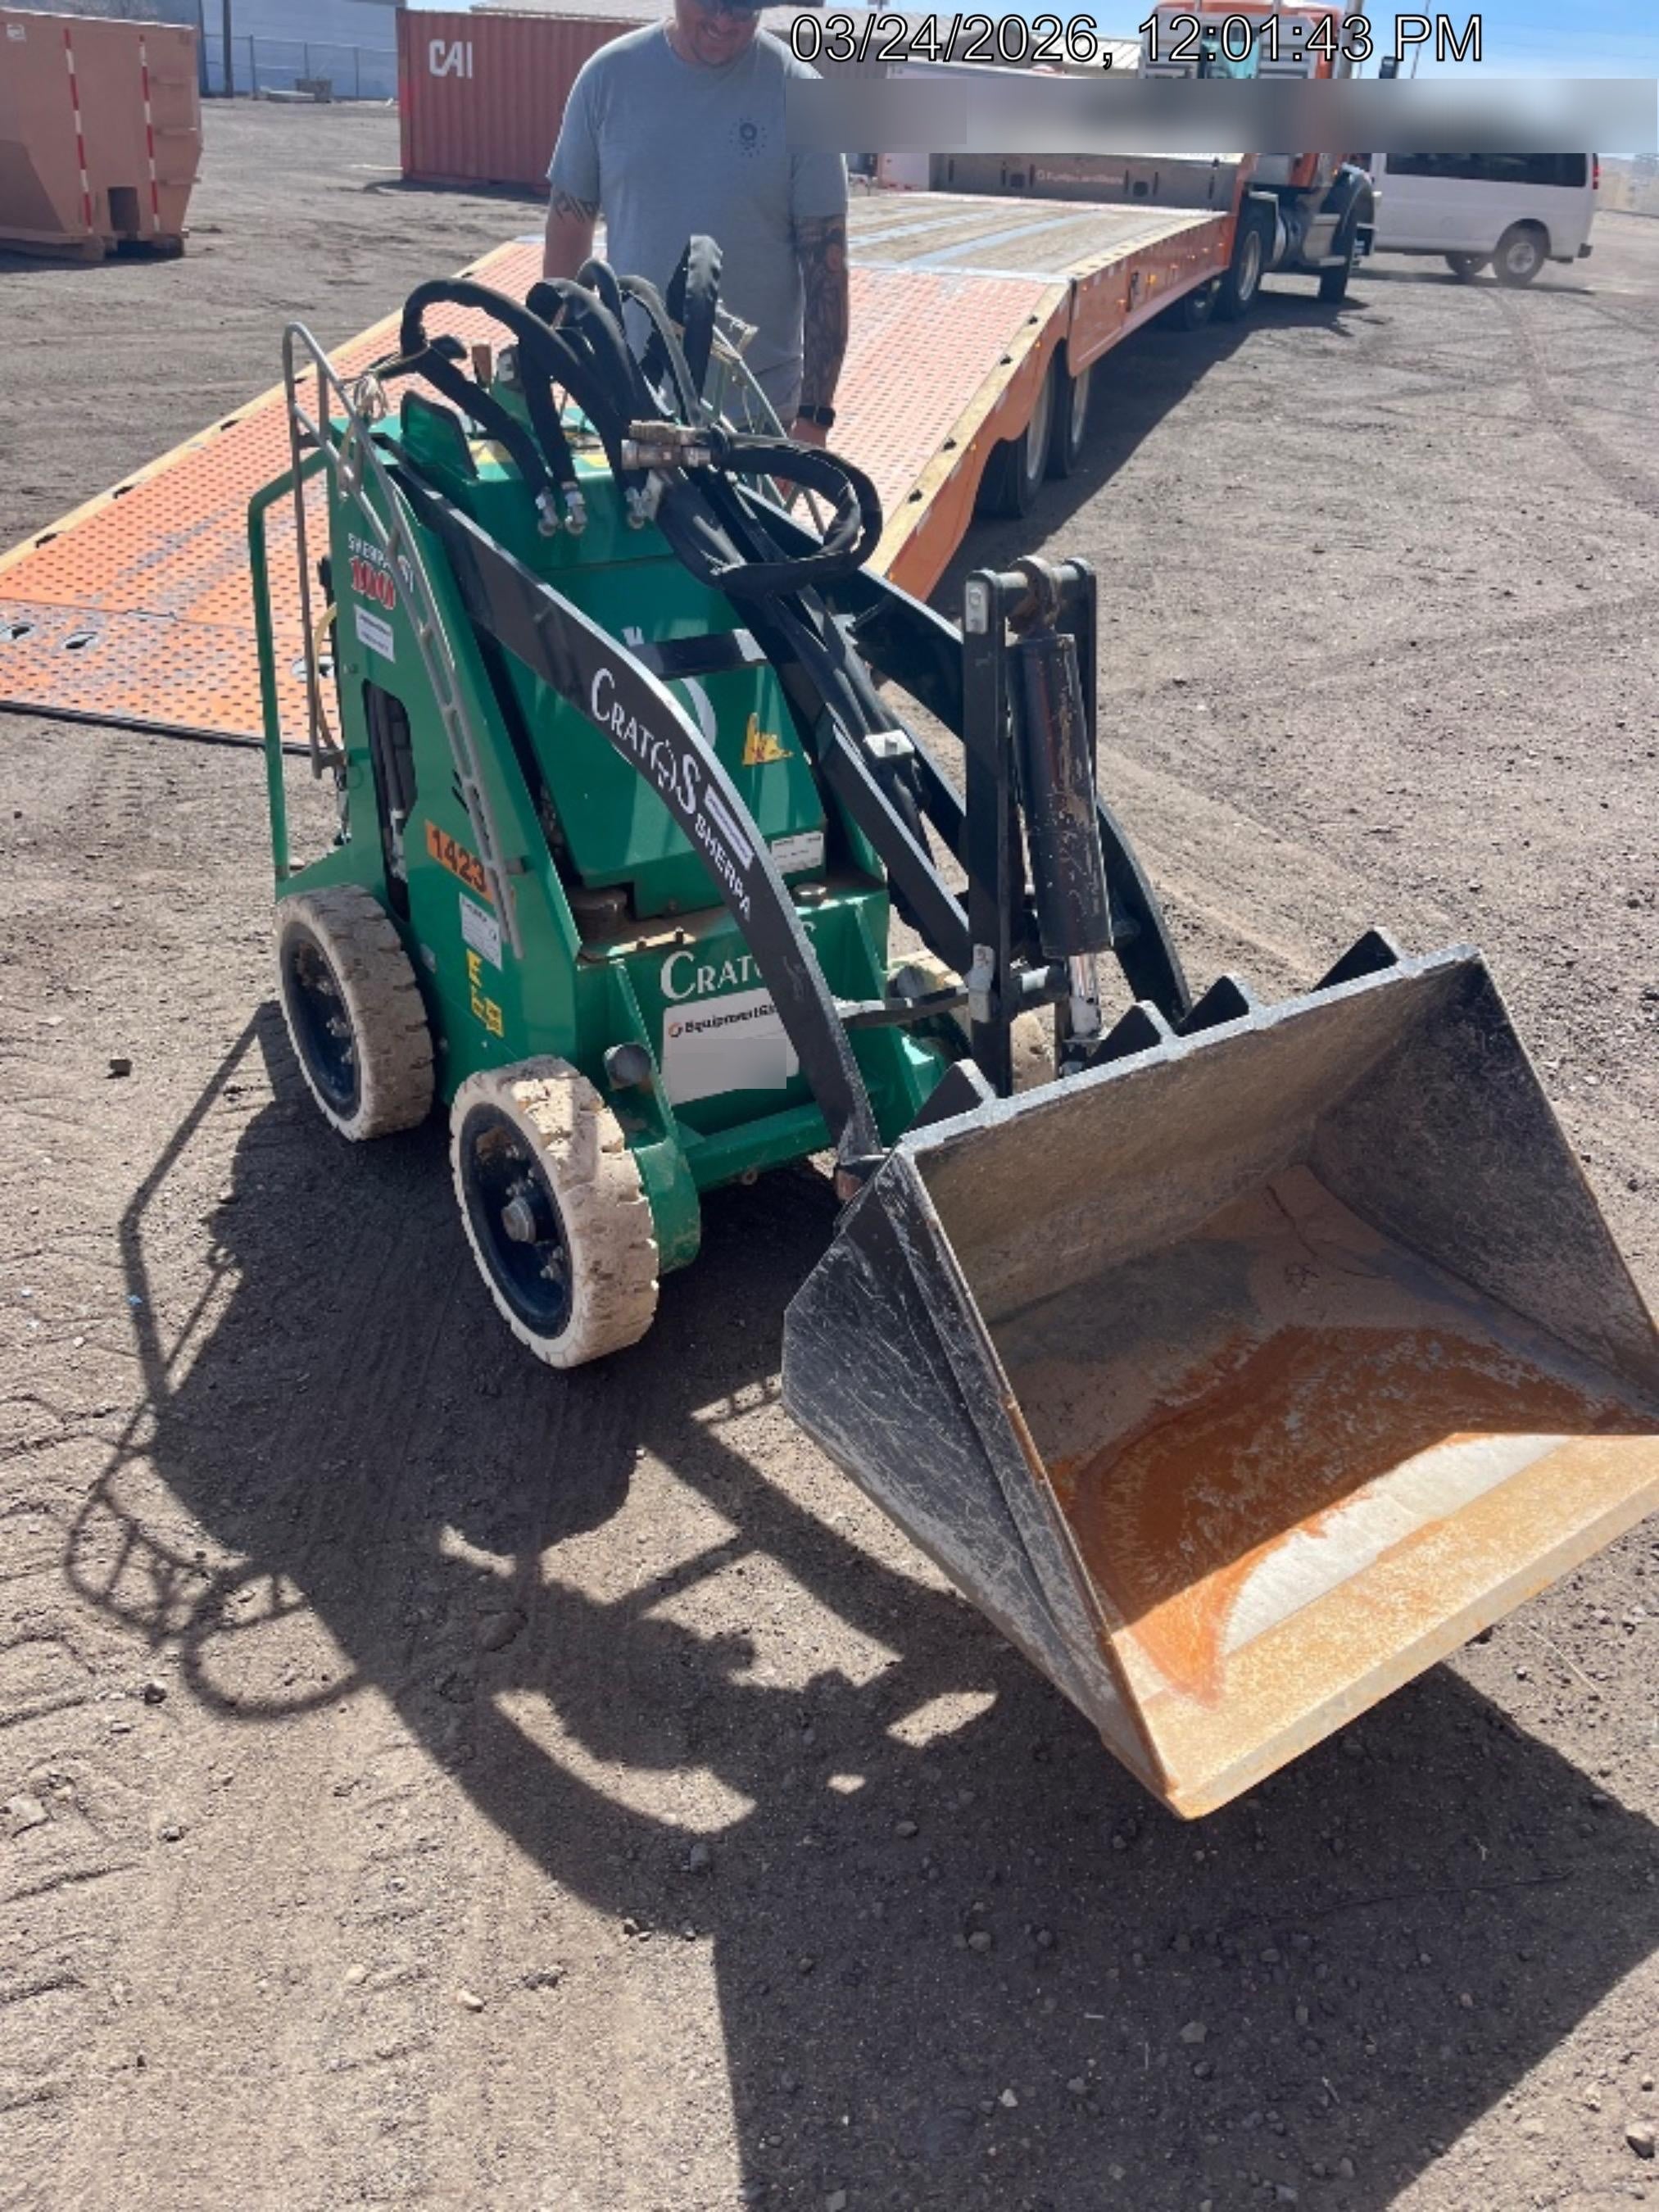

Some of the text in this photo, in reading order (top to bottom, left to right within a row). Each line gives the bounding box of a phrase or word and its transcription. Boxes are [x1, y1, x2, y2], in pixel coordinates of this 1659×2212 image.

[428, 39, 474, 79] CAI
[591, 667, 701, 815] CRATOS
[431, 829, 488, 893] 1423
[660, 950, 763, 1001] CRAT
